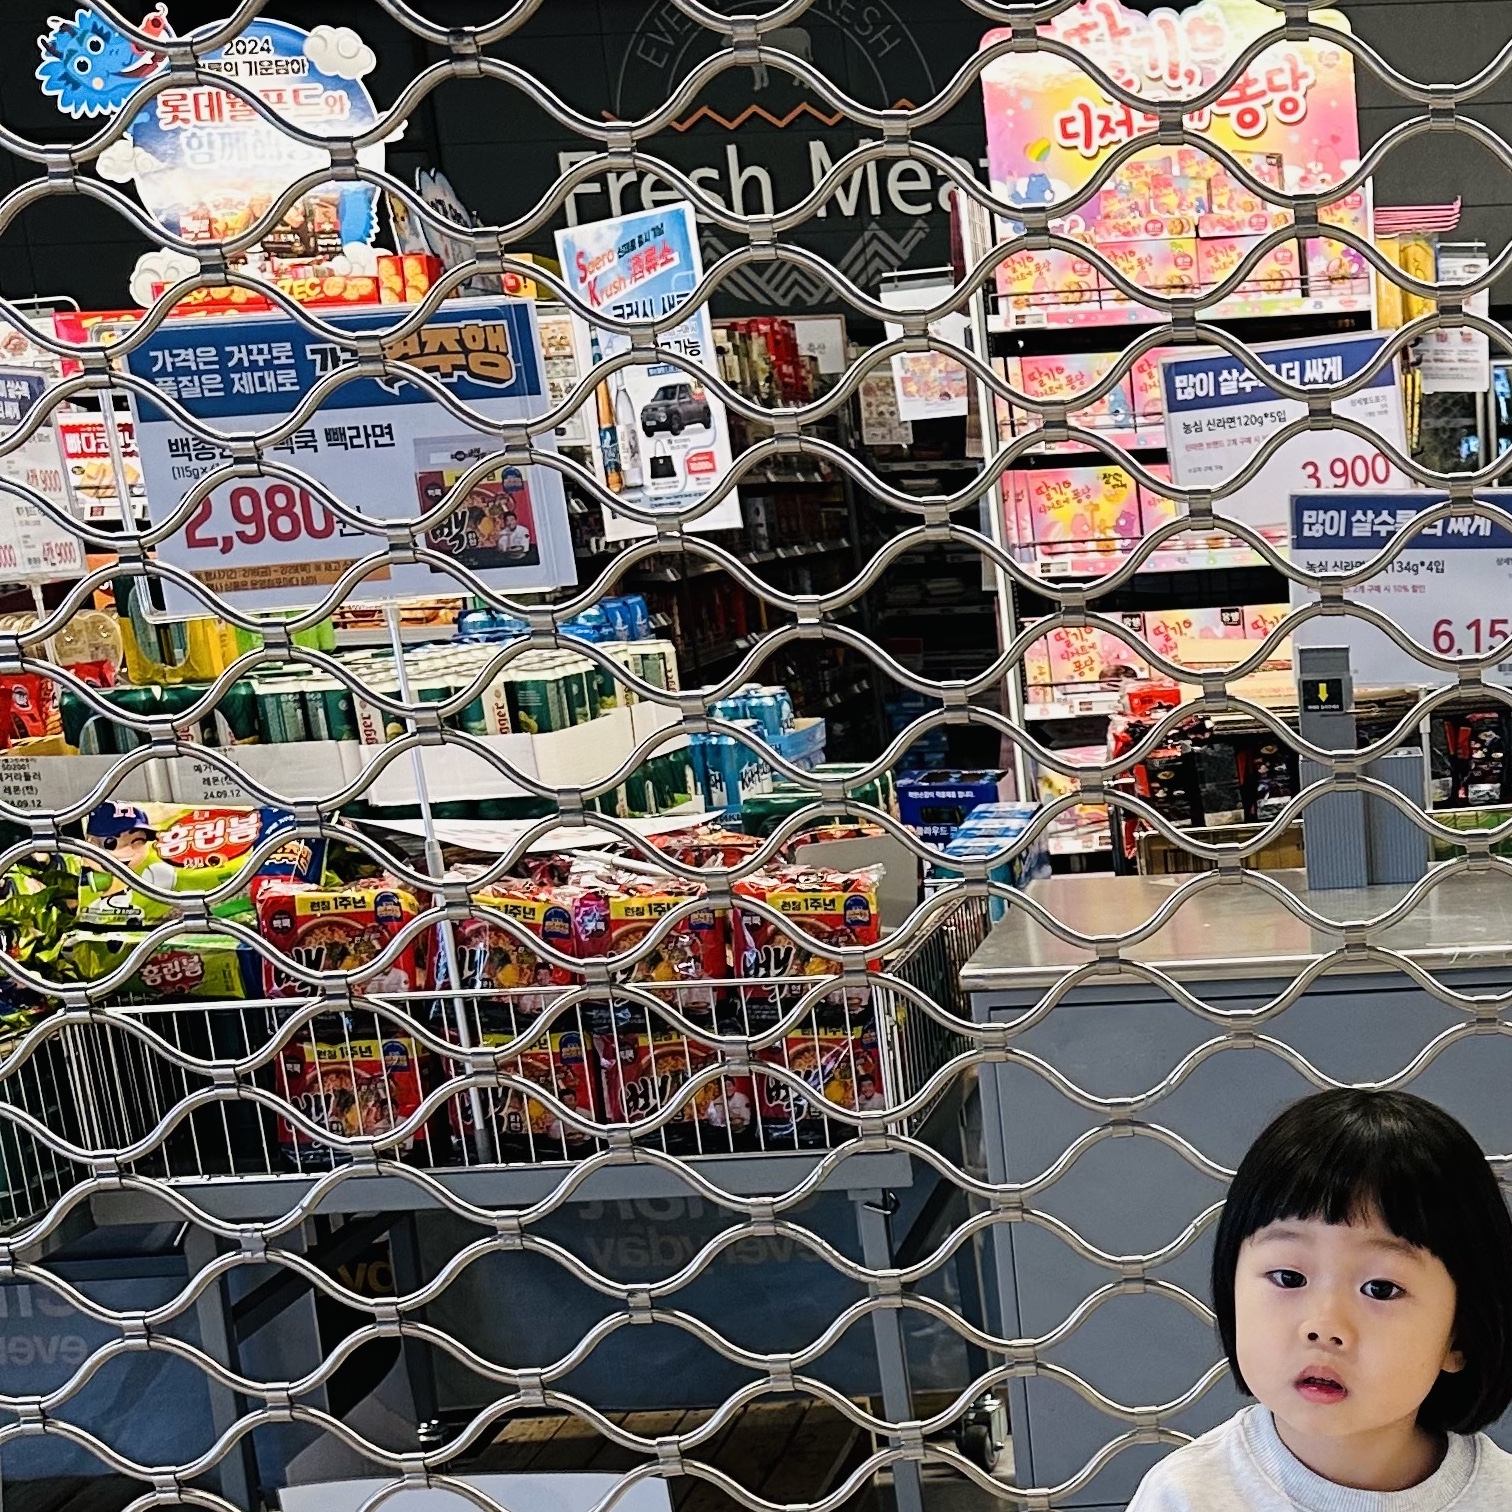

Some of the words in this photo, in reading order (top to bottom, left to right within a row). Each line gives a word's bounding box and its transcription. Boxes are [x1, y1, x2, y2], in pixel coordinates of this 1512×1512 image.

[223, 38, 273, 56] 2024
[199, 59, 240, 77] 룡의
[243, 58, 309, 77] 기운담아
[1215, 53, 1309, 130] 퐁당
[557, 143, 775, 228] Fresh
[809, 137, 989, 219] Mea
[575, 247, 615, 284] Saero
[587, 272, 627, 308] Krush
[149, 347, 219, 373] 가격은
[224, 341, 296, 368] 거꾸로
[305, 342, 357, 377] 가
[153, 372, 225, 400] 품질은
[231, 369, 300, 395] 제대로
[1174, 371, 1215, 401] 많이
[1218, 364, 1275, 396] 살수
[1280, 360, 1301, 386] 더
[1303, 355, 1343, 384] 싸게
[64, 430, 140, 454] 빠다코낫
[1182, 419, 1203, 435] 농심
[166, 435, 246, 463] 백종
[323, 423, 396, 452] 빽라면
[1302, 508, 1347, 538] 많이
[1446, 515, 1493, 537] 싸게
[1305, 559, 1329, 574] 농심
[203, 789, 242, 800] 24.09.12
[154, 811, 262, 859] 홈런볼
[310, 899, 332, 912] 런칭
[333, 895, 367, 910] 1주년
[624, 904, 646, 917] 런칭
[804, 896, 837, 911] 1주년
[140, 954, 204, 987] 홈런볼
